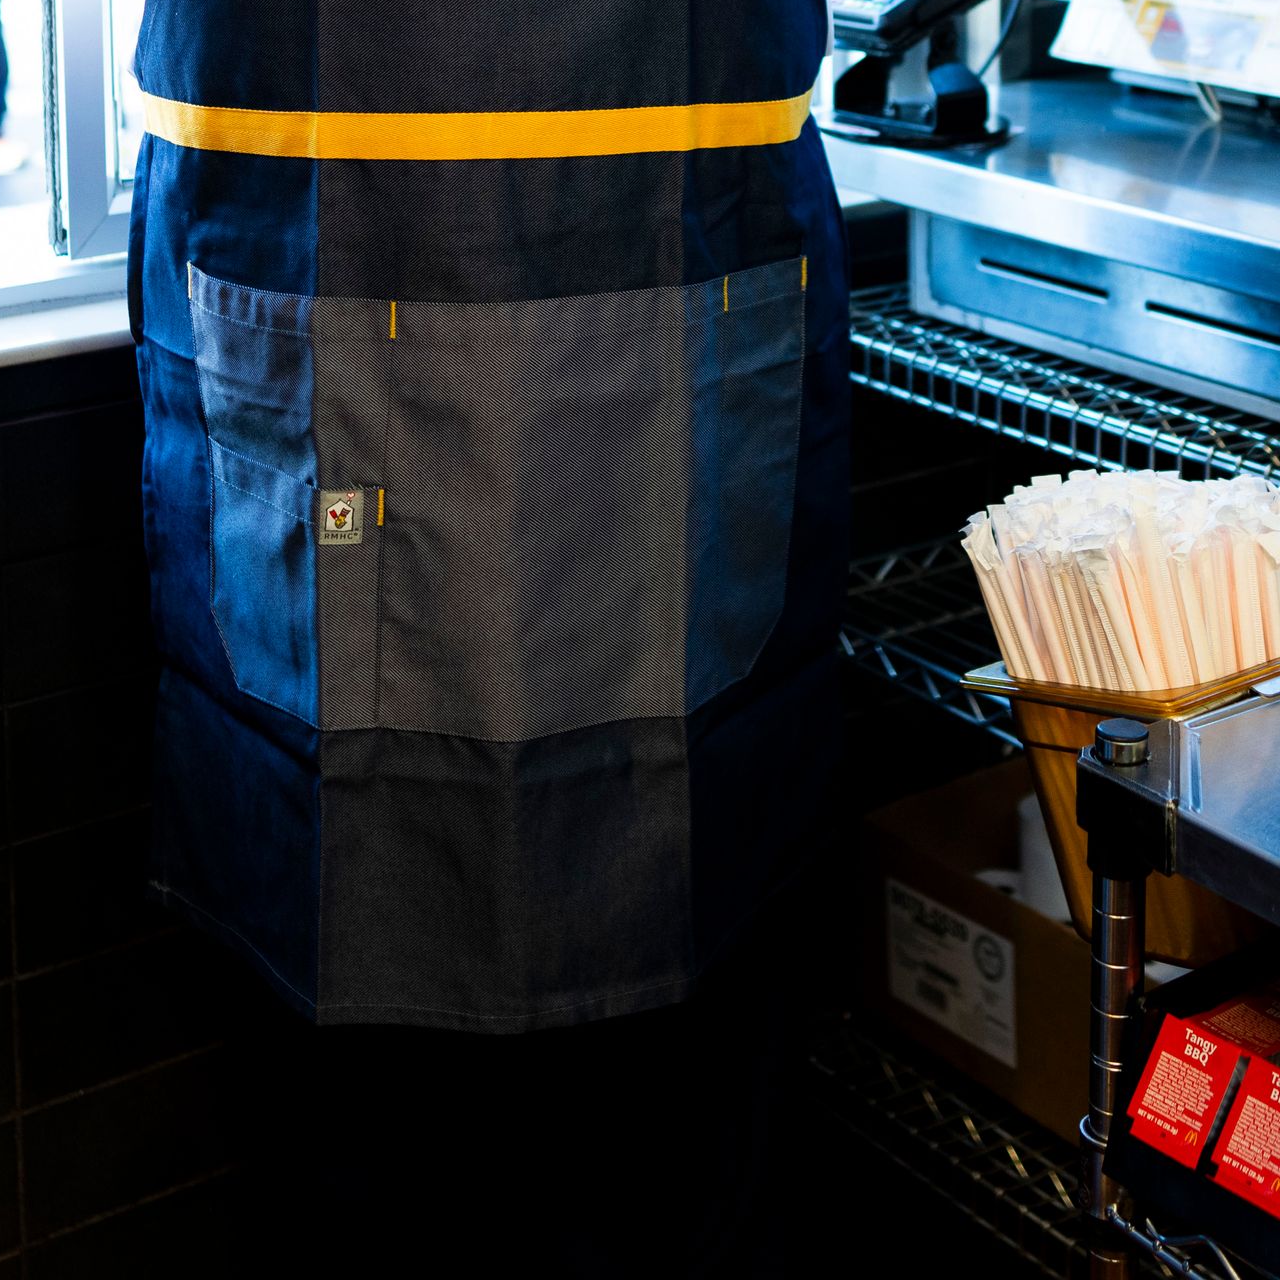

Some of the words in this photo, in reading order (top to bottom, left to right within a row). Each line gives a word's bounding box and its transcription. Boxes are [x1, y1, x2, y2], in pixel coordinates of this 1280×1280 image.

[1185, 1028, 1217, 1055] Tangy
[1184, 1044, 1209, 1066] BBQ
[1136, 1107, 1147, 1117] NET
[1221, 1154, 1232, 1164] NET
